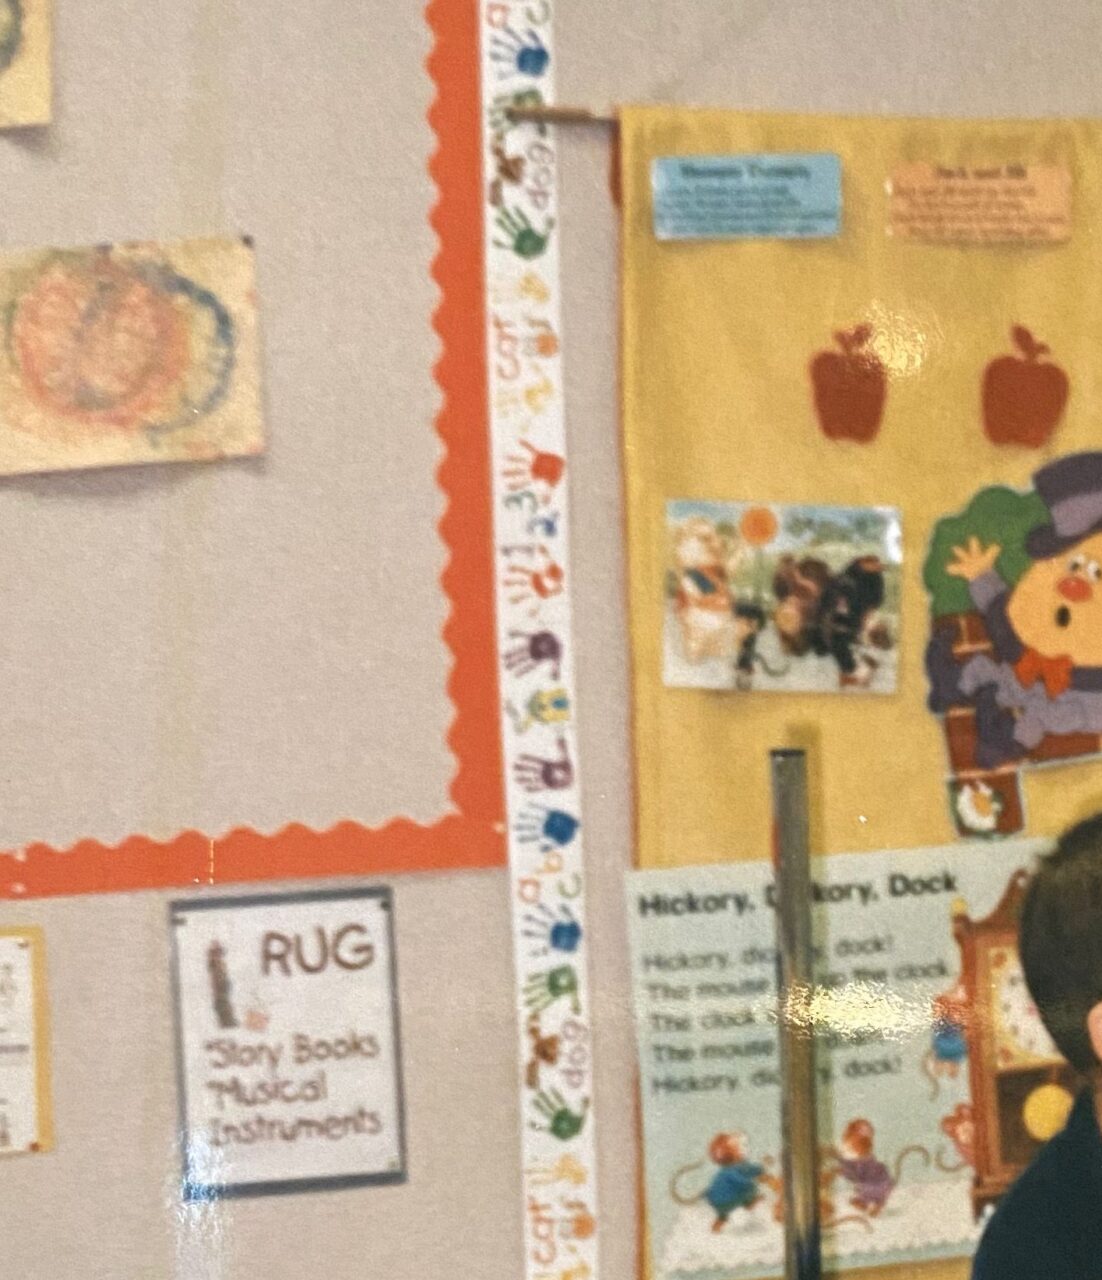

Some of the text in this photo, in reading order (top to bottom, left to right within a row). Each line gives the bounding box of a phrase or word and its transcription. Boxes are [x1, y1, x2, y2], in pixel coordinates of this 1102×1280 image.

[639, 870, 956, 917] Hickory, Dkory, Dock
[261, 923, 375, 977] RUG
[204, 1030, 380, 1072] Story Books
[557, 1020, 592, 1091] dog
[207, 1070, 328, 1110] Musical
[208, 1107, 382, 1147] Instruments
